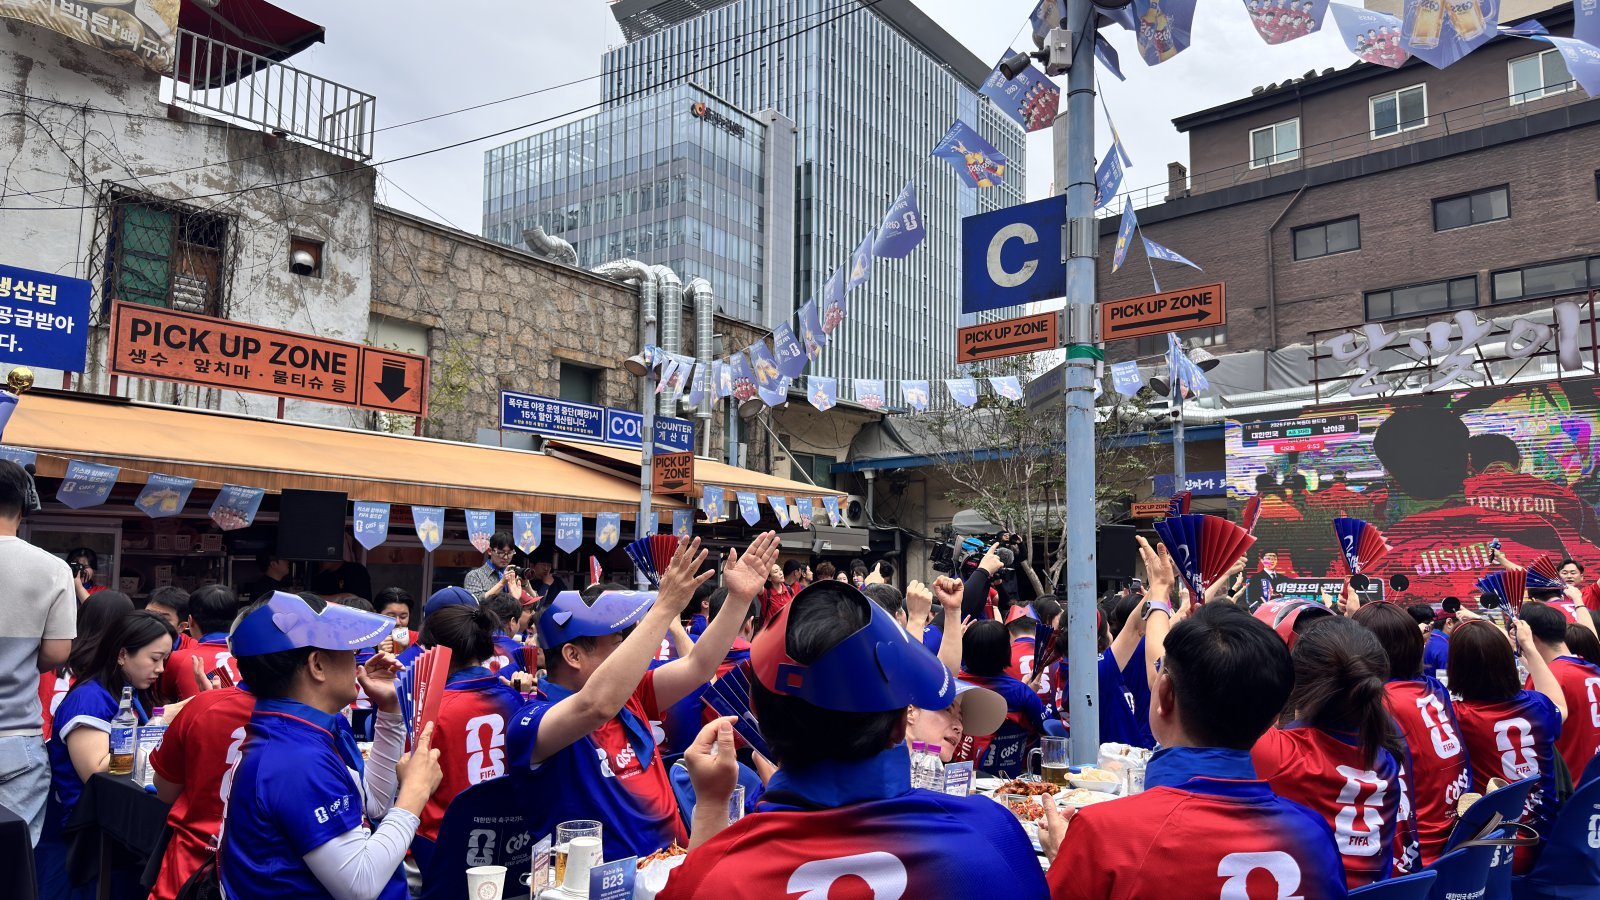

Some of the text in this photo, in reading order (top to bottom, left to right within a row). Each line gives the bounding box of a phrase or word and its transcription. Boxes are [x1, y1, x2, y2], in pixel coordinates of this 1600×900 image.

[986, 222, 1039, 288] C
[1110, 292, 1212, 320] PICK UP ZONE
[0, 306, 75, 334] 공급받아
[964, 320, 1048, 344] PICK UP ZONE
[130, 318, 347, 376] PICK UP ZONE
[128, 348, 346, 394] 생수 앞치마 물티슈 등
[530, 402, 545, 412] 야장
[546, 404, 560, 414] 운영
[520, 410, 537, 420] 15%
[538, 412, 552, 423] 할인
[553, 415, 588, 427] 계산됩니다.
[656, 420, 692, 434] COUNTER
[1251, 430, 1279, 439] 대한민국
[1322, 425, 1345, 433] 남아공
[656, 456, 691, 468] PICK UP
[1000, 741, 1019, 759] Cass
[1442, 742, 1455, 752] FIFA
[480, 769, 496, 780] FIFA
[1516, 766, 1531, 775] FIFA
[1349, 835, 1369, 847] FIFA
[602, 873, 624, 890] B23
